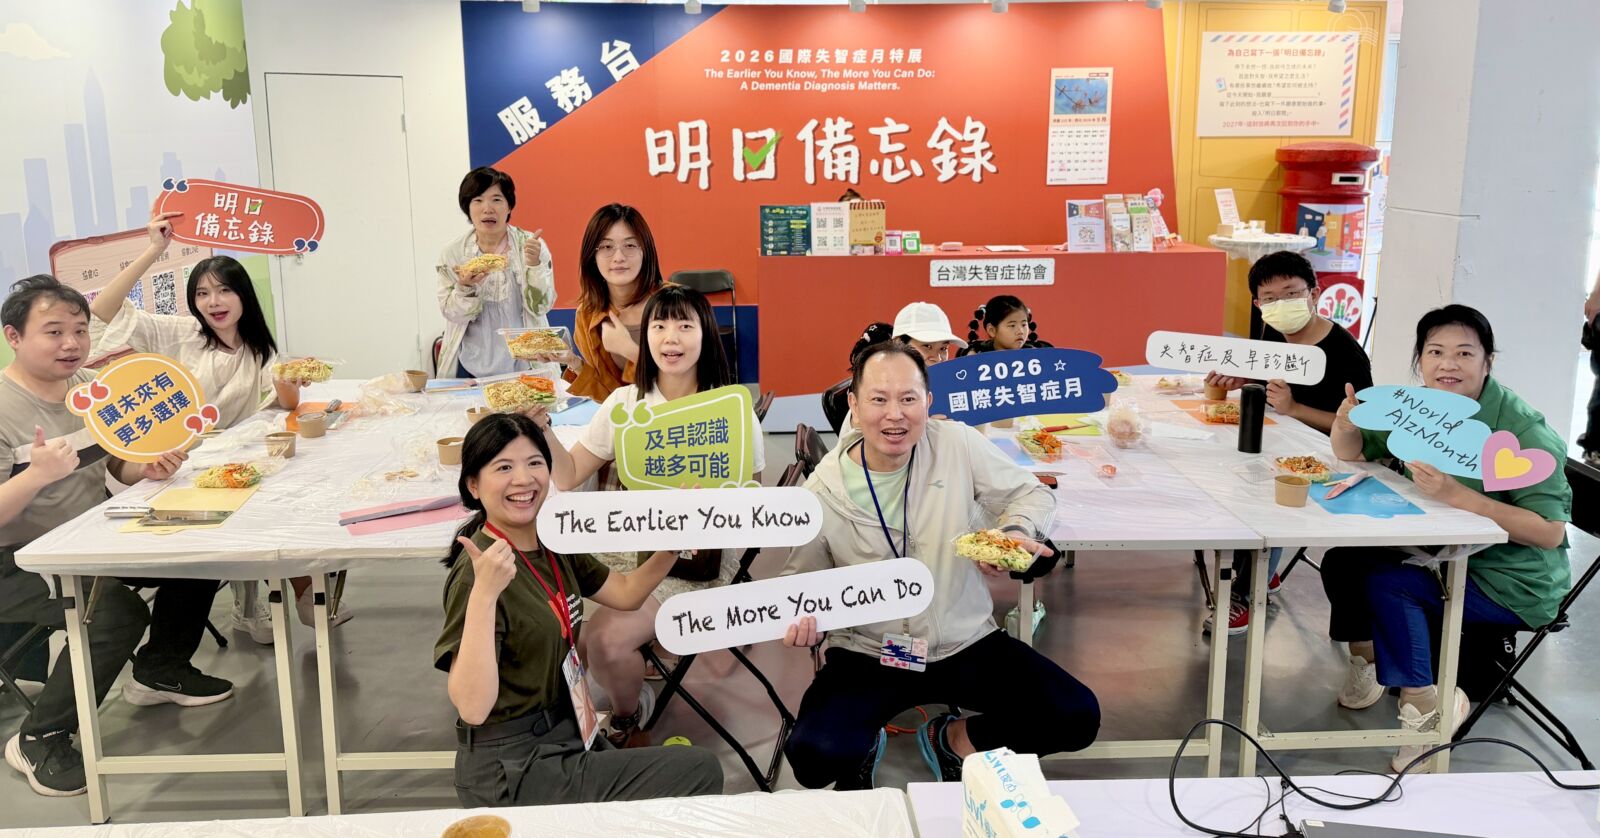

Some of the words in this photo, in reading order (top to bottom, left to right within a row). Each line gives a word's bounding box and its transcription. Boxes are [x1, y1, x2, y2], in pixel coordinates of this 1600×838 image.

[720, 48, 922, 64] 2026國際失智症月特展
[704, 68, 723, 78] The
[727, 68, 761, 79] Earlier
[764, 68, 783, 79] You
[786, 68, 818, 80] Know,
[821, 68, 840, 79] The
[843, 68, 869, 78] More
[872, 68, 891, 78] You
[894, 68, 914, 78] Can
[917, 68, 936, 78] Do:
[740, 81, 748, 91] A
[751, 81, 800, 91] Dementia
[804, 81, 855, 92] Diagnosis
[858, 81, 900, 91] Matters.
[497, 40, 641, 145] 服務台
[644, 116, 999, 190] 明日備忘錄
[213, 192, 263, 215] 明日
[195, 212, 275, 245] 備忘錄
[937, 263, 1047, 282] 台灣失智症協會
[977, 358, 1042, 382] 2026
[1160, 341, 1311, 377] 失智症及早診斷
[96, 371, 175, 428] 讓未來有
[948, 376, 1083, 414] 國際失智症月
[1392, 388, 1464, 435] #World
[113, 390, 191, 448] 更多選擇
[644, 416, 729, 451] 及早認識
[1385, 408, 1478, 472] AlzMonth
[644, 451, 730, 479] 越多可能
[554, 509, 597, 535] The
[607, 507, 689, 533] Earlier
[697, 505, 743, 530] You
[751, 504, 811, 529] Know
[672, 610, 716, 637] The
[726, 604, 781, 630] More
[787, 592, 833, 617] You
[841, 585, 886, 608] Can
[893, 577, 923, 600] Do
